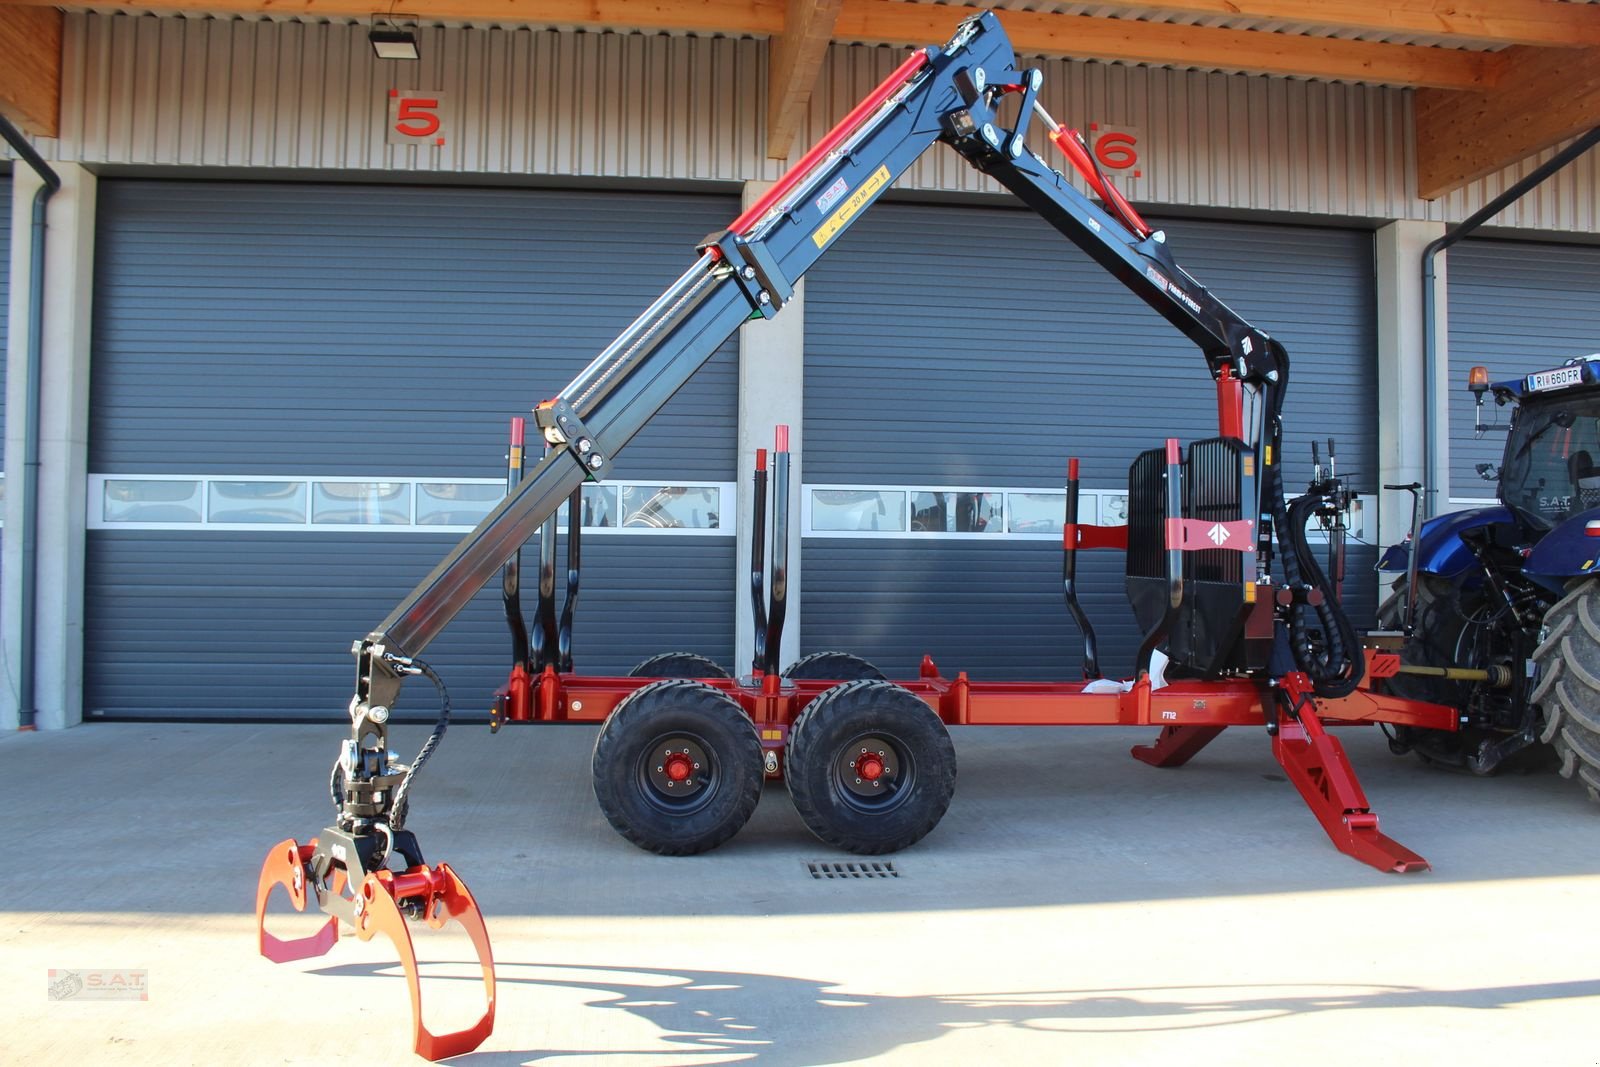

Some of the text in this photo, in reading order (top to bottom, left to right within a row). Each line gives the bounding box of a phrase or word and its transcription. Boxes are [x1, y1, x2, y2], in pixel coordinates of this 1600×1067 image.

[395, 98, 440, 137] 5
[1094, 132, 1137, 169] 6
[851, 189, 868, 208] 20 M
[1536, 376, 1546, 388] RI
